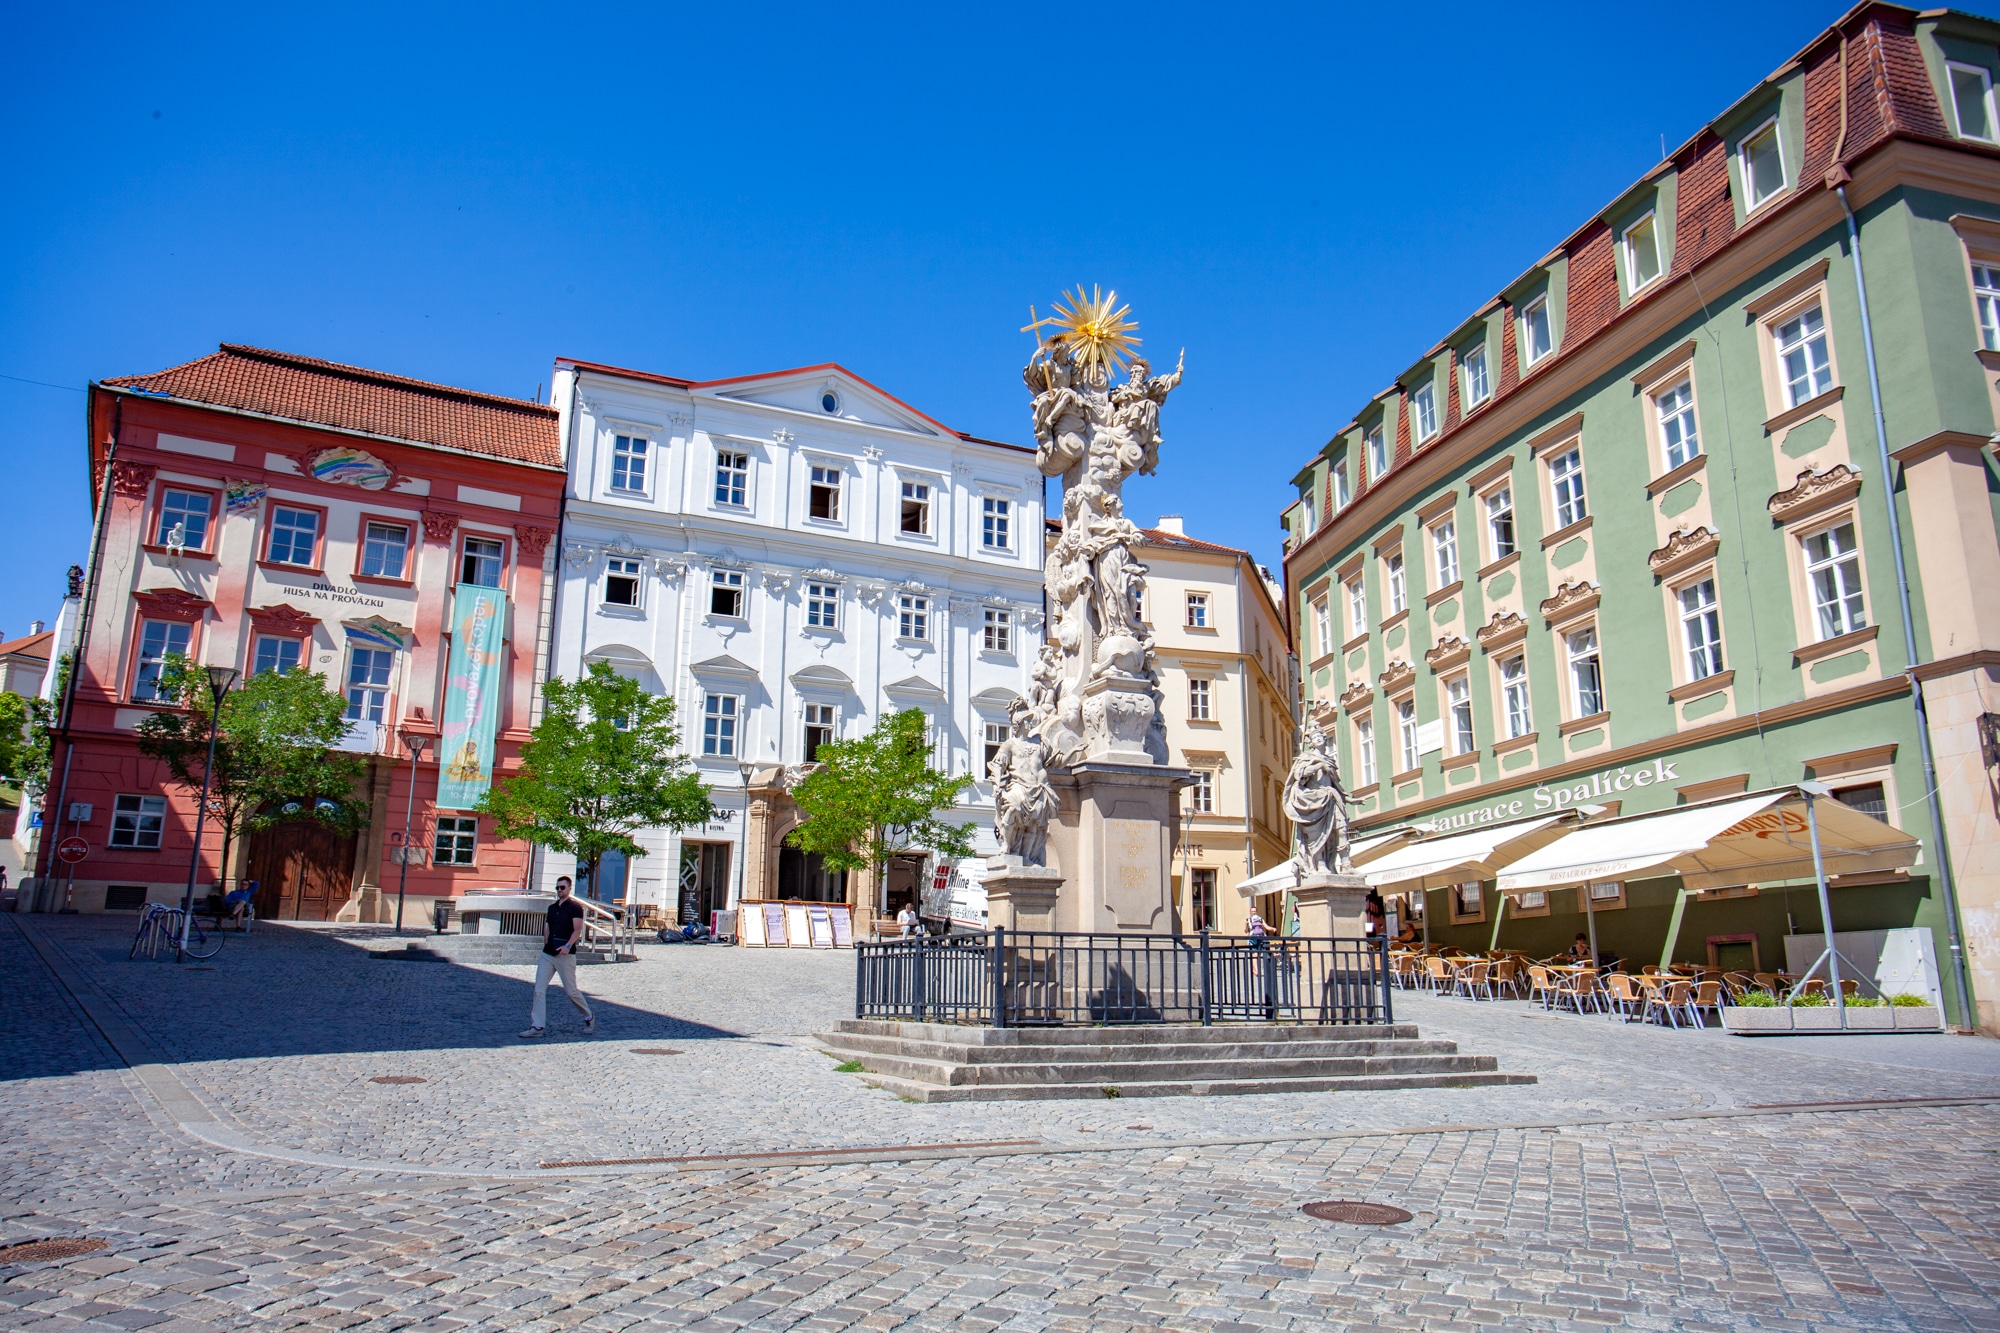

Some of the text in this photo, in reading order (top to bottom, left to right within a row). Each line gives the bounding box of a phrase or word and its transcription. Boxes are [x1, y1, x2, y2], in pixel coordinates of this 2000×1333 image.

[283, 587, 384, 608] HUSA NA PROVÁZKU
[312, 582, 358, 596] DIVADLO
[1394, 758, 1680, 833] taurace Špalíček
